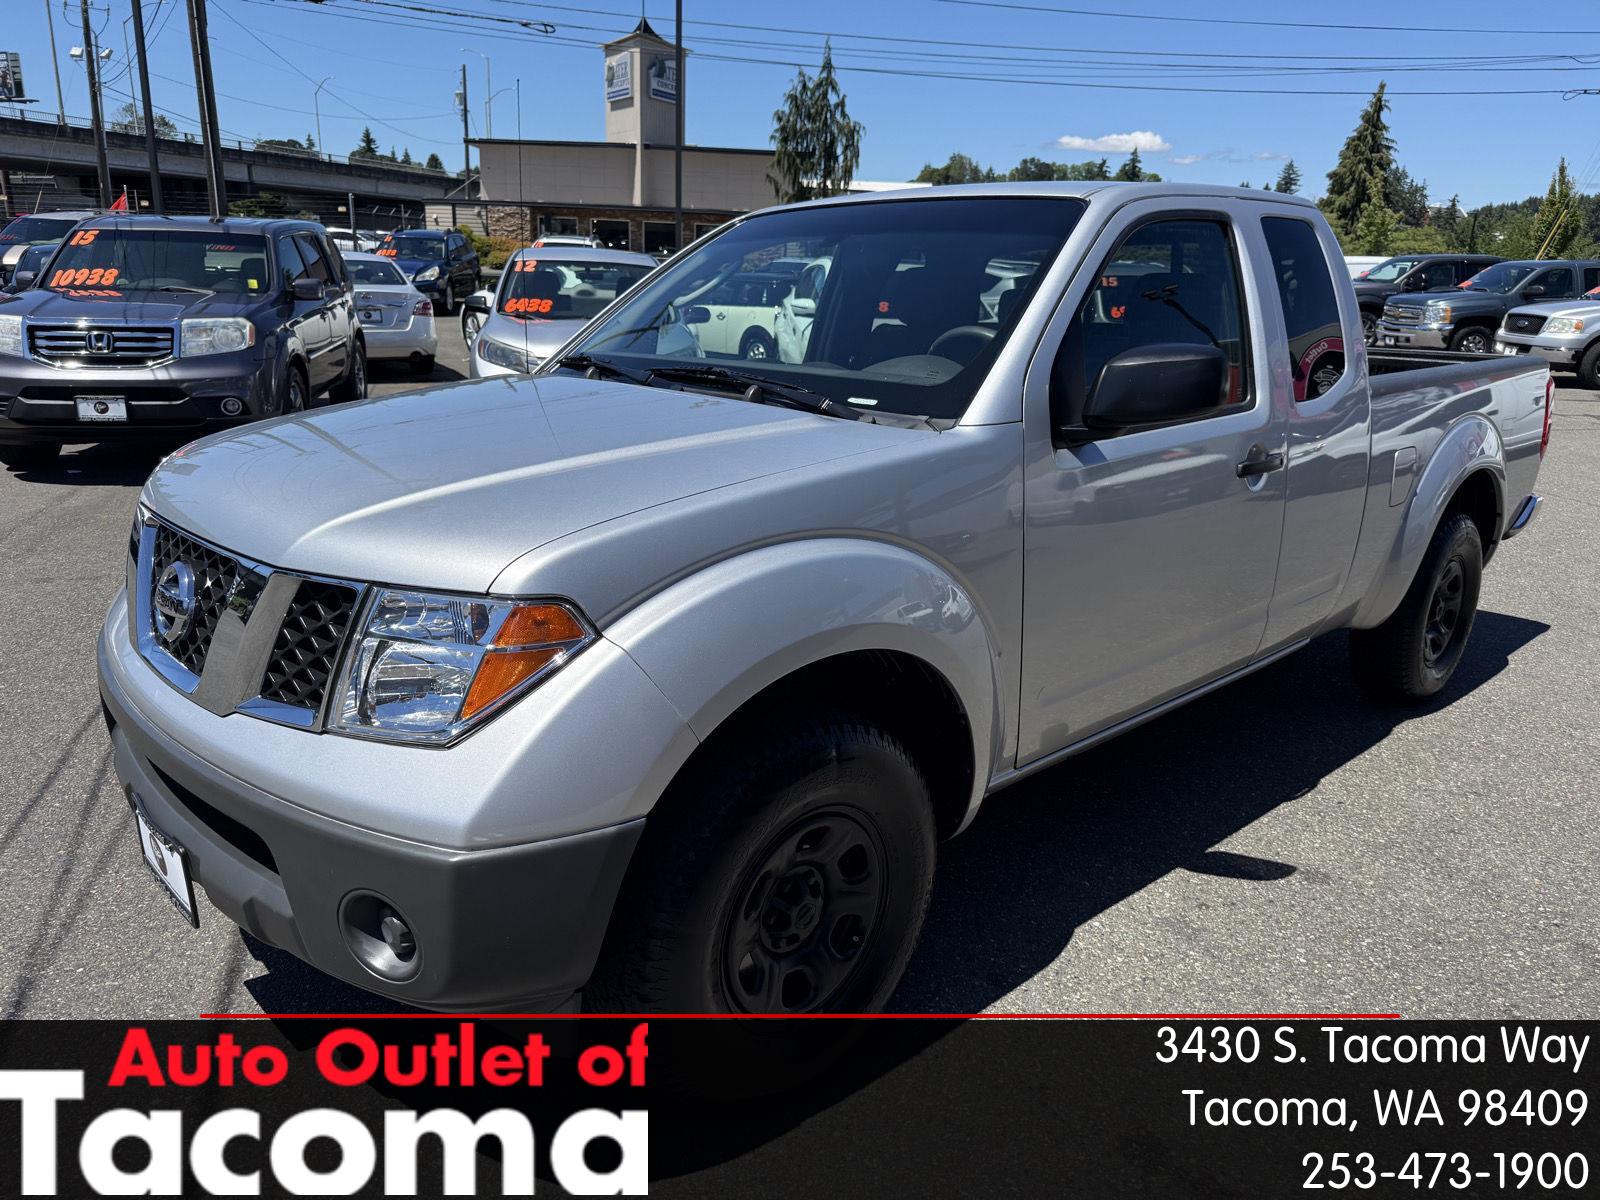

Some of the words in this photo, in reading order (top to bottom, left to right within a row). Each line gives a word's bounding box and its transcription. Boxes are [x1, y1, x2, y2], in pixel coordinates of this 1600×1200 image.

[70, 225, 99, 241] 15
[514, 260, 537, 272] 12
[49, 268, 119, 288] 10938
